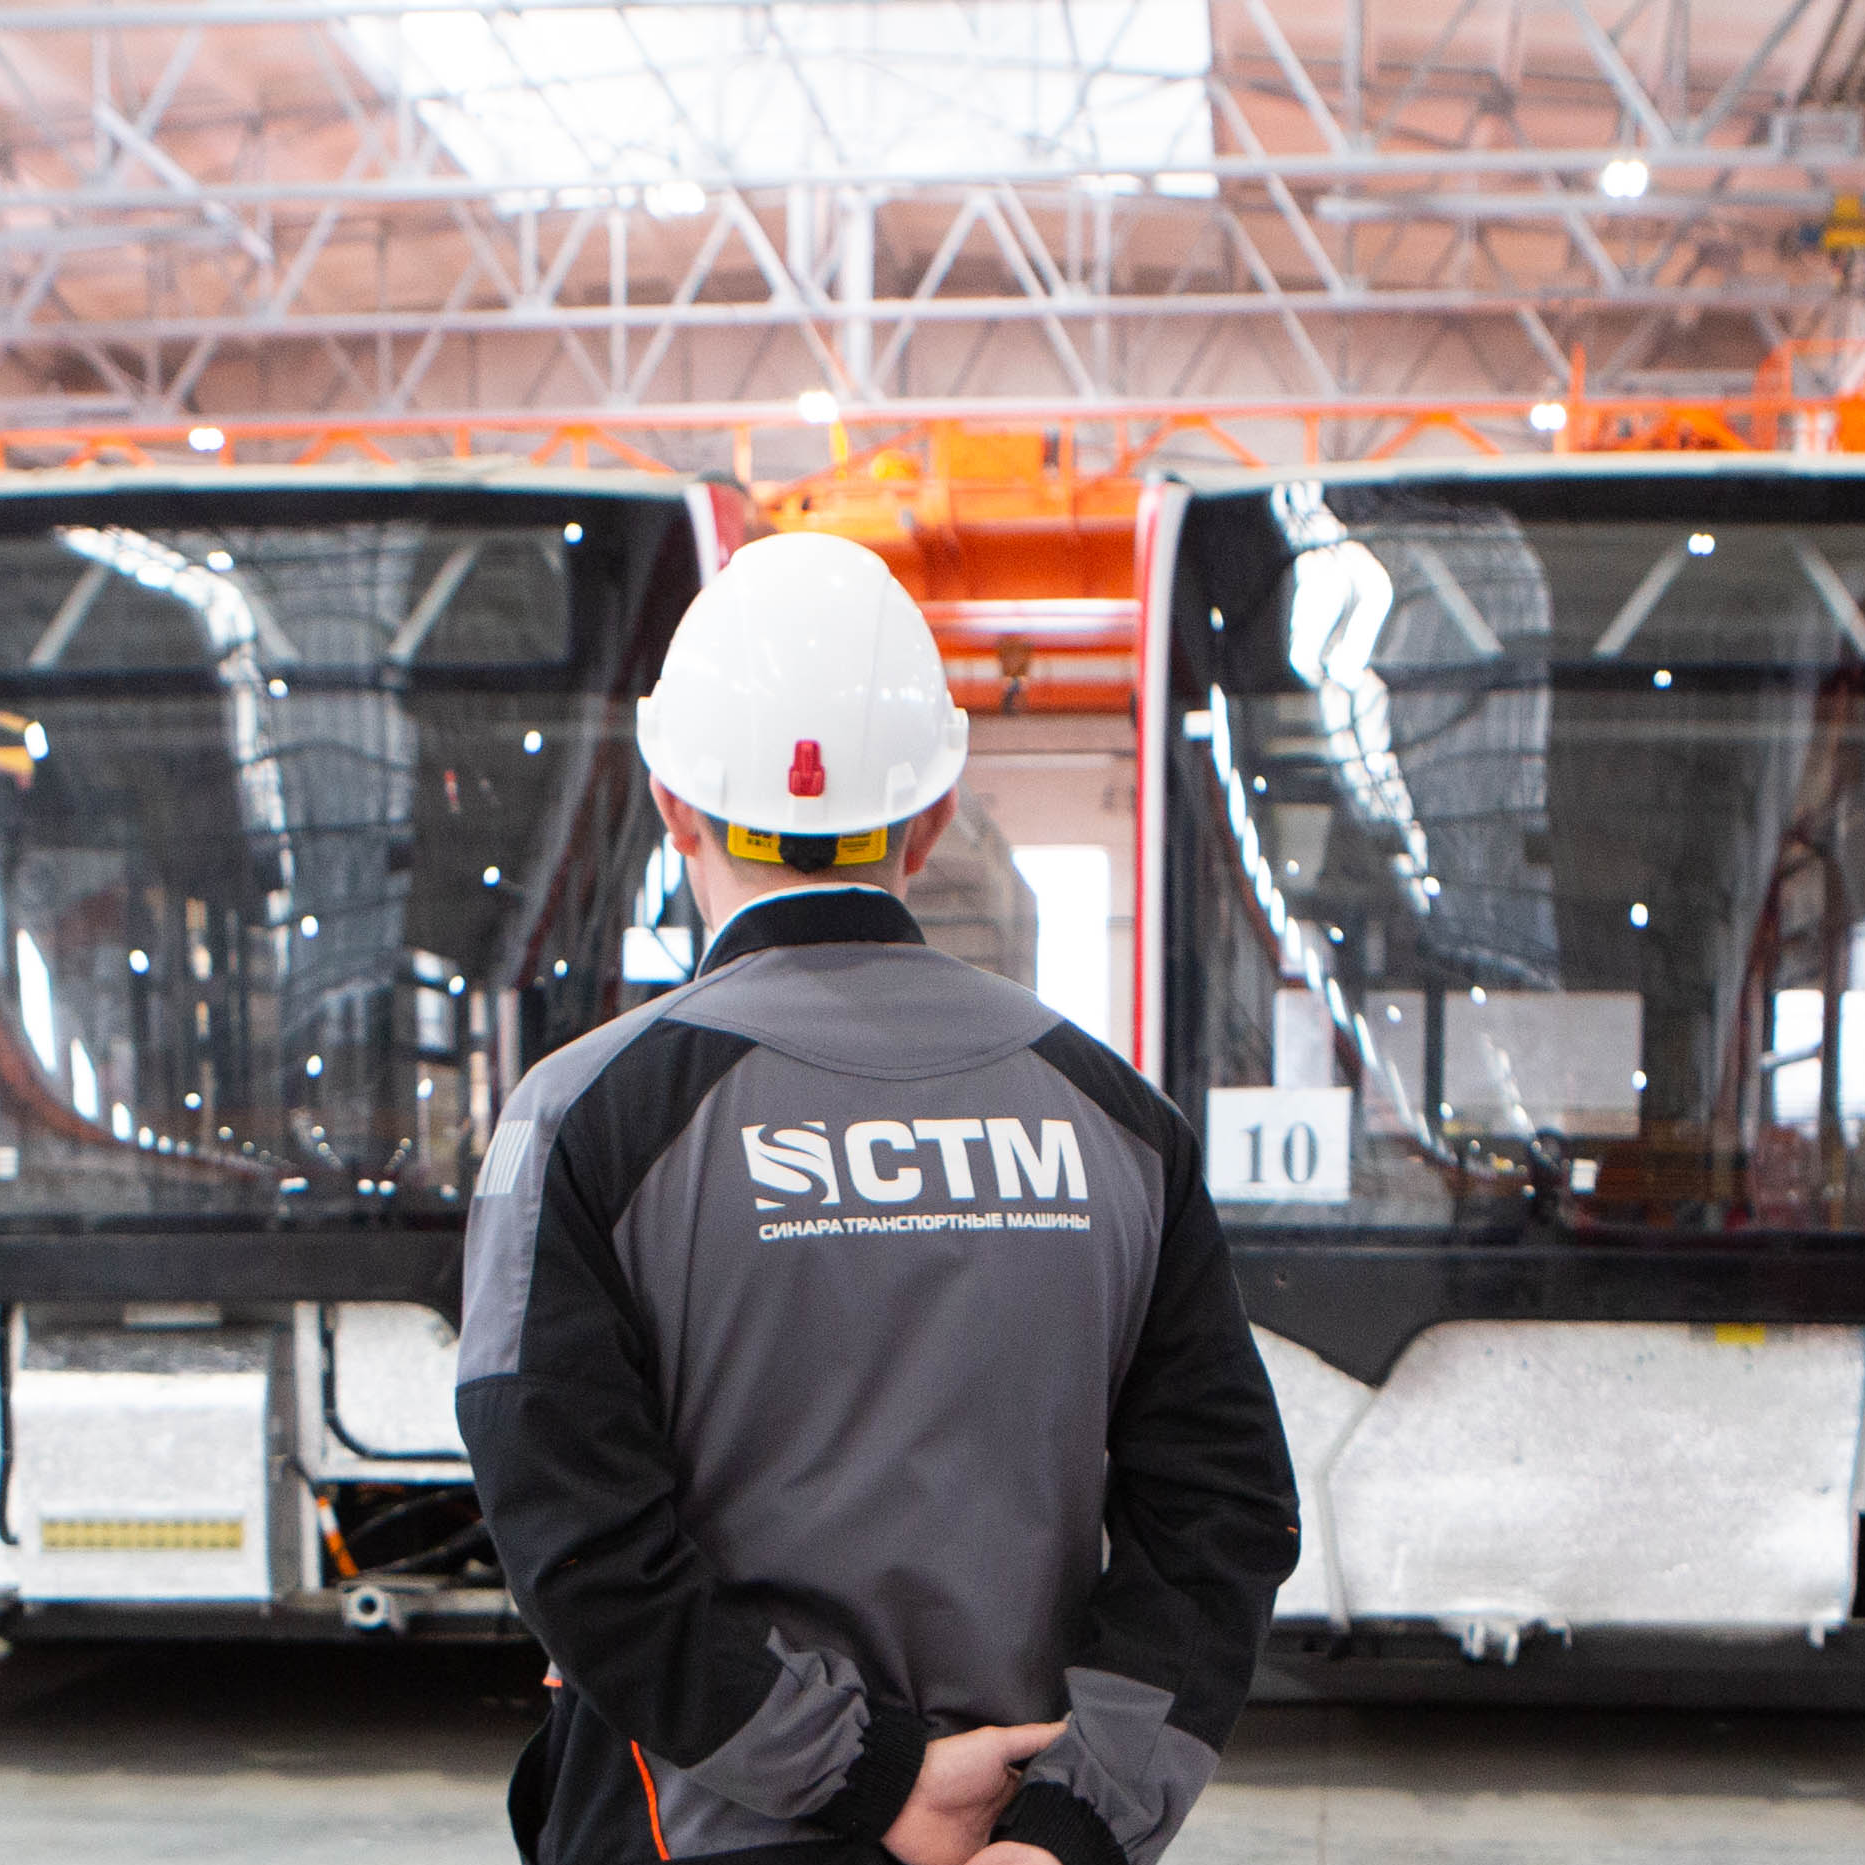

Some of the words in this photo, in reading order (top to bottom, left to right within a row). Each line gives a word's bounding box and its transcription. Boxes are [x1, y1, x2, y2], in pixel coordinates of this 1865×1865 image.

[1239, 1121, 1320, 1184] 10
[759, 1218, 845, 1241] СИНАРА
[843, 1212, 1004, 1233] ТРАНСПОРТНЫЕ
[1006, 1212, 1091, 1232] МАШИНЫ
